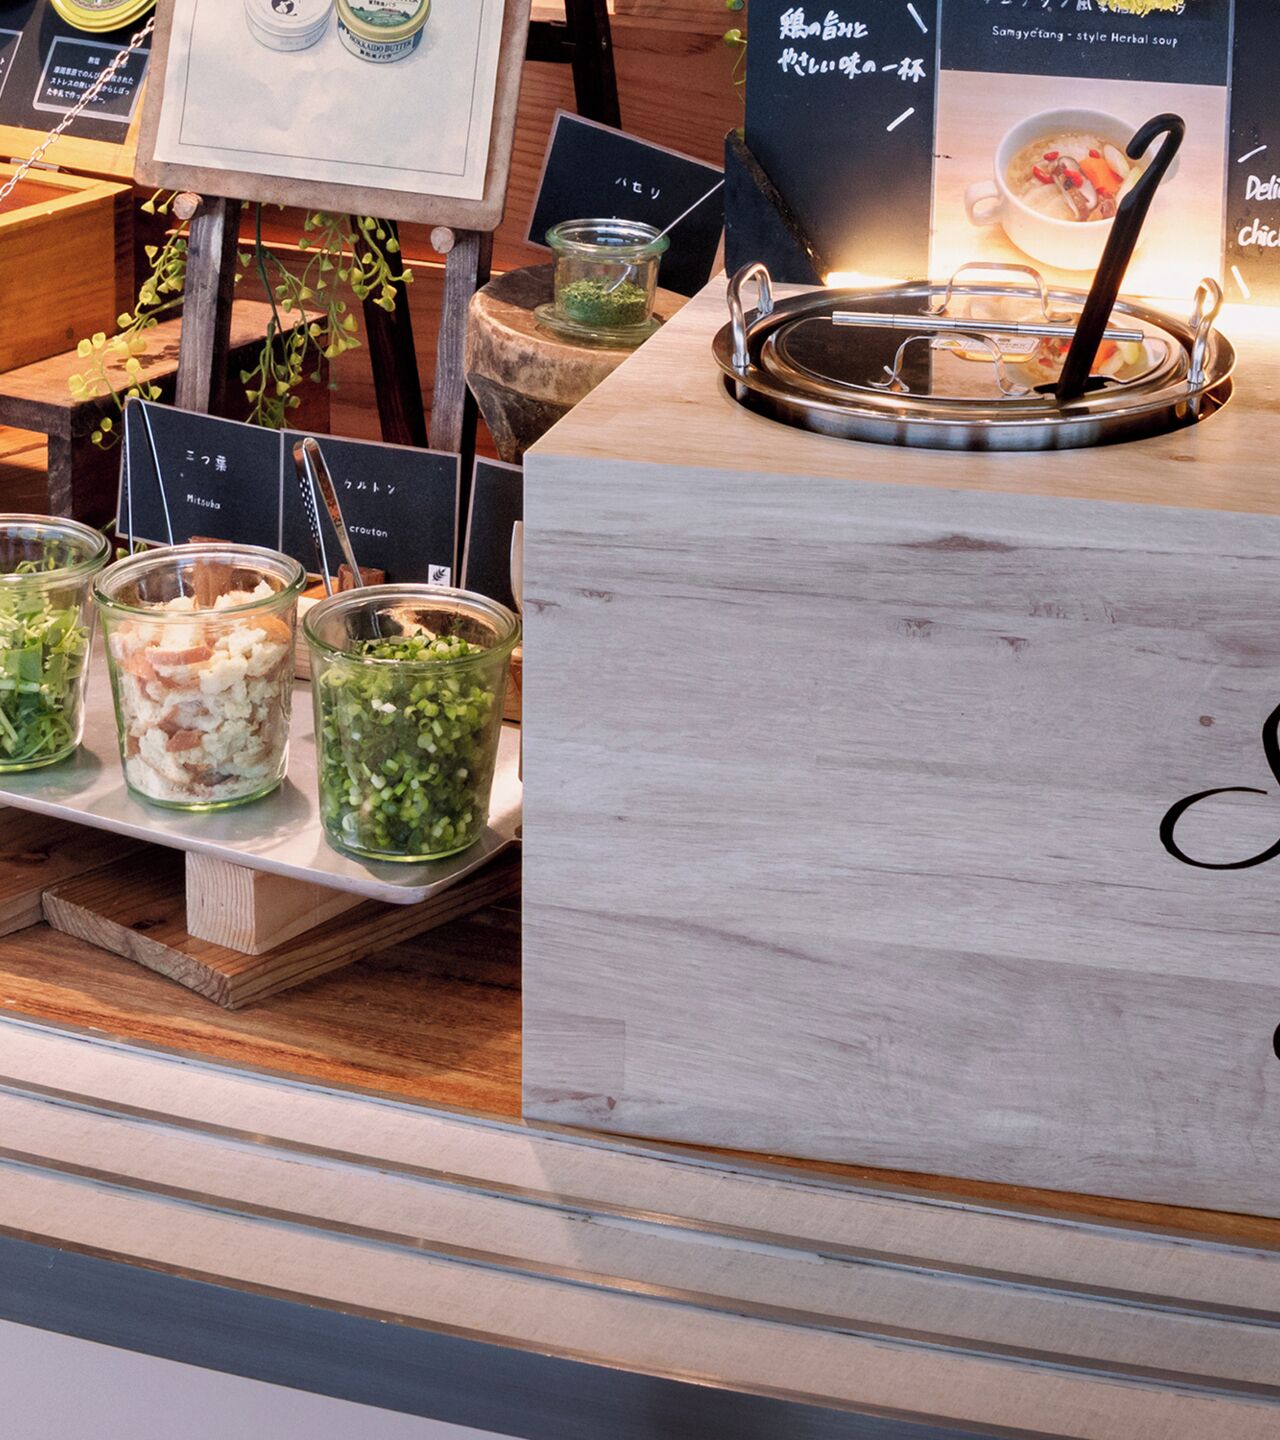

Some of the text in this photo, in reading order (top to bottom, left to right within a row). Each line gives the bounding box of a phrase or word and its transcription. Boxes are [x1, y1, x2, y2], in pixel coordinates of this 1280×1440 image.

[779, 7, 869, 41] 鶏の旨みと
[349, 34, 413, 53] HOKKAIDO BUTTER
[992, 25, 1064, 42] Samgyetang
[1076, 32, 1108, 45] style
[1111, 32, 1149, 45] Herbal
[1152, 36, 1178, 48] soup
[777, 47, 927, 83] やさしい味の一杯
[186, 449, 228, 472] 三つ葉
[186, 494, 221, 510] Mitsuba
[349, 525, 388, 538] crouton
